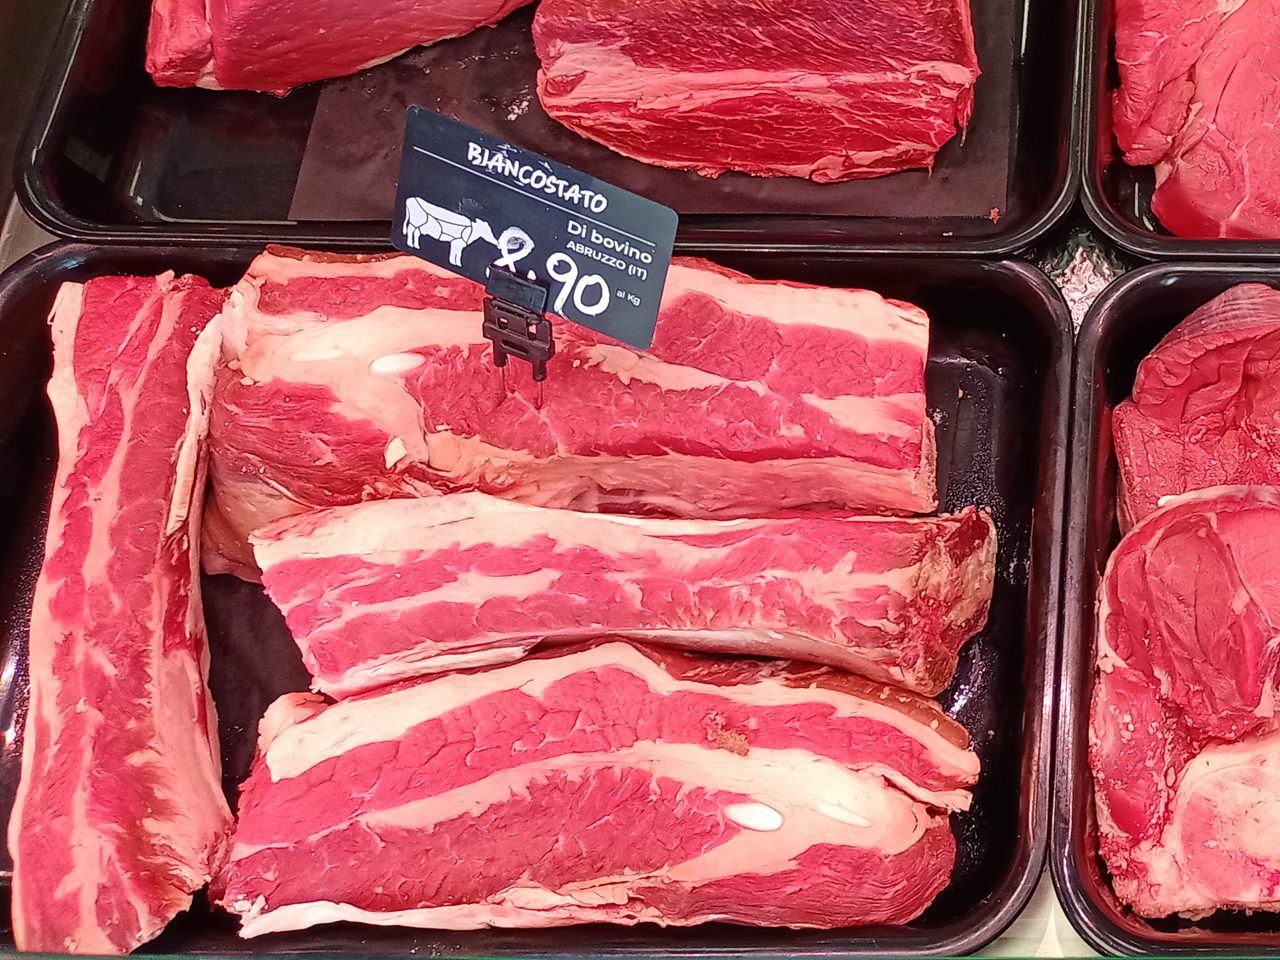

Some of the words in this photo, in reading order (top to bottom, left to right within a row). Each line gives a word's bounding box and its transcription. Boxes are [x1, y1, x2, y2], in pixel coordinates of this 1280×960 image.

[467, 142, 608, 214] BIANCOSTATO
[566, 240, 626, 270] ABRUZZO
[628, 264, 648, 281] (IT)
[568, 220, 588, 238] Di
[591, 228, 653, 264] bovino
[627, 294, 641, 306] Kg
